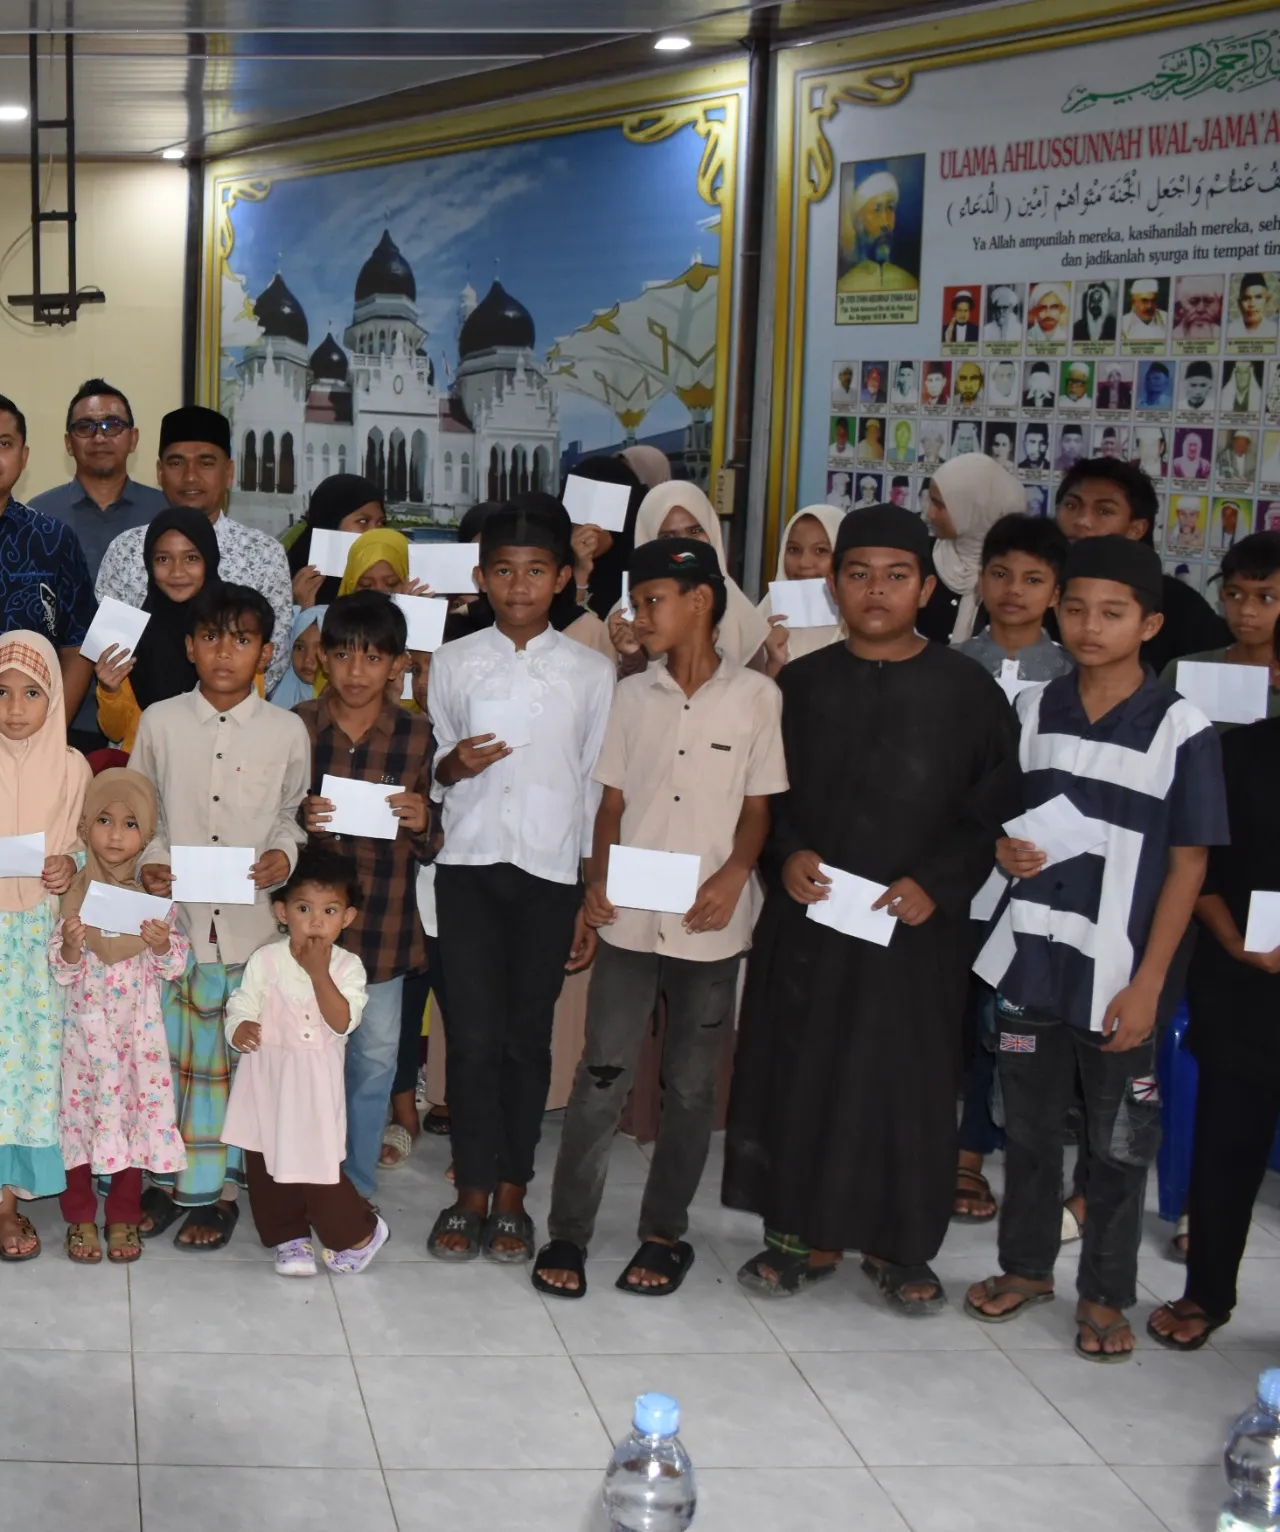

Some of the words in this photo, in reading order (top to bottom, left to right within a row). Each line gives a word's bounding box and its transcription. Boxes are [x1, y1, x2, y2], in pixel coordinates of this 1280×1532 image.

[939, 144, 998, 180] ULAMA
[1002, 126, 1142, 173] AHLUSSUNNAH
[972, 236, 986, 251] Ya
[989, 234, 1016, 249] Allah
[1018, 230, 1075, 250] ampunilah
[1078, 227, 1124, 243] mereka,
[1128, 221, 1197, 242] kasihanilah
[1201, 217, 1253, 236] mereka,
[1061, 252, 1082, 267] dan
[1085, 247, 1145, 269] jadikanlah
[1148, 249, 1188, 266] syurga
[1192, 244, 1209, 260] itu
[1213, 241, 1260, 261] tempat
